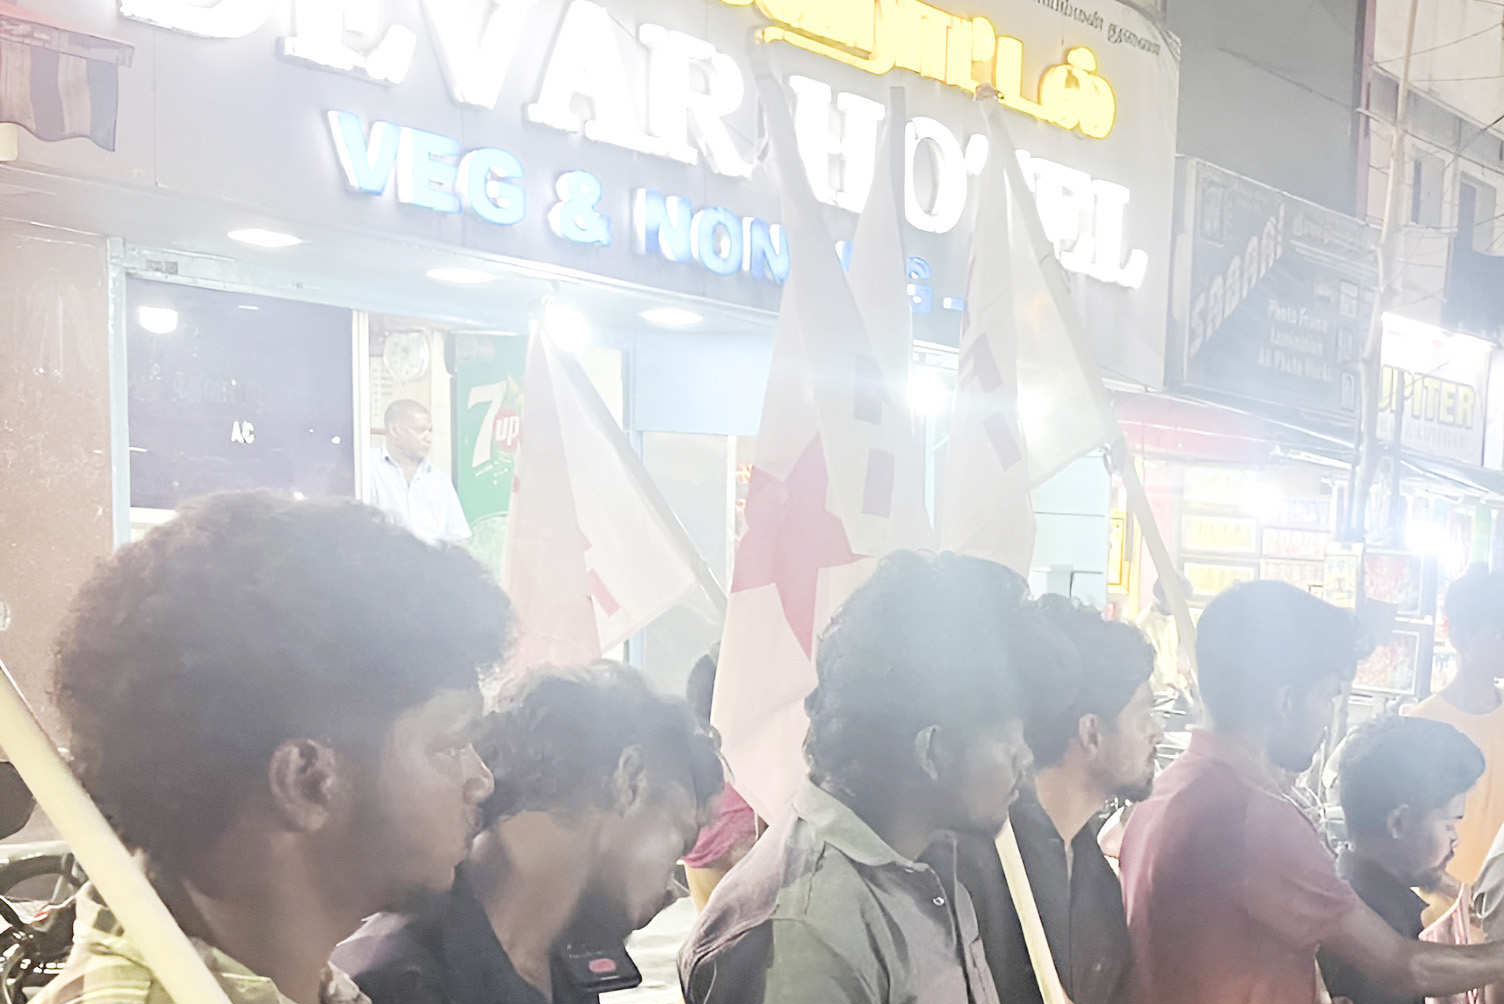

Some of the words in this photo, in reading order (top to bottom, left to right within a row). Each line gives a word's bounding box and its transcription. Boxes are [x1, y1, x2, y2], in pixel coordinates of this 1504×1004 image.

[118, 0, 754, 178] EVAR
[327, 110, 526, 225] VEG
[547, 169, 613, 248] &
[230, 420, 256, 445] AC
[467, 380, 508, 468] 7
[1377, 364, 1476, 430] UPITER
